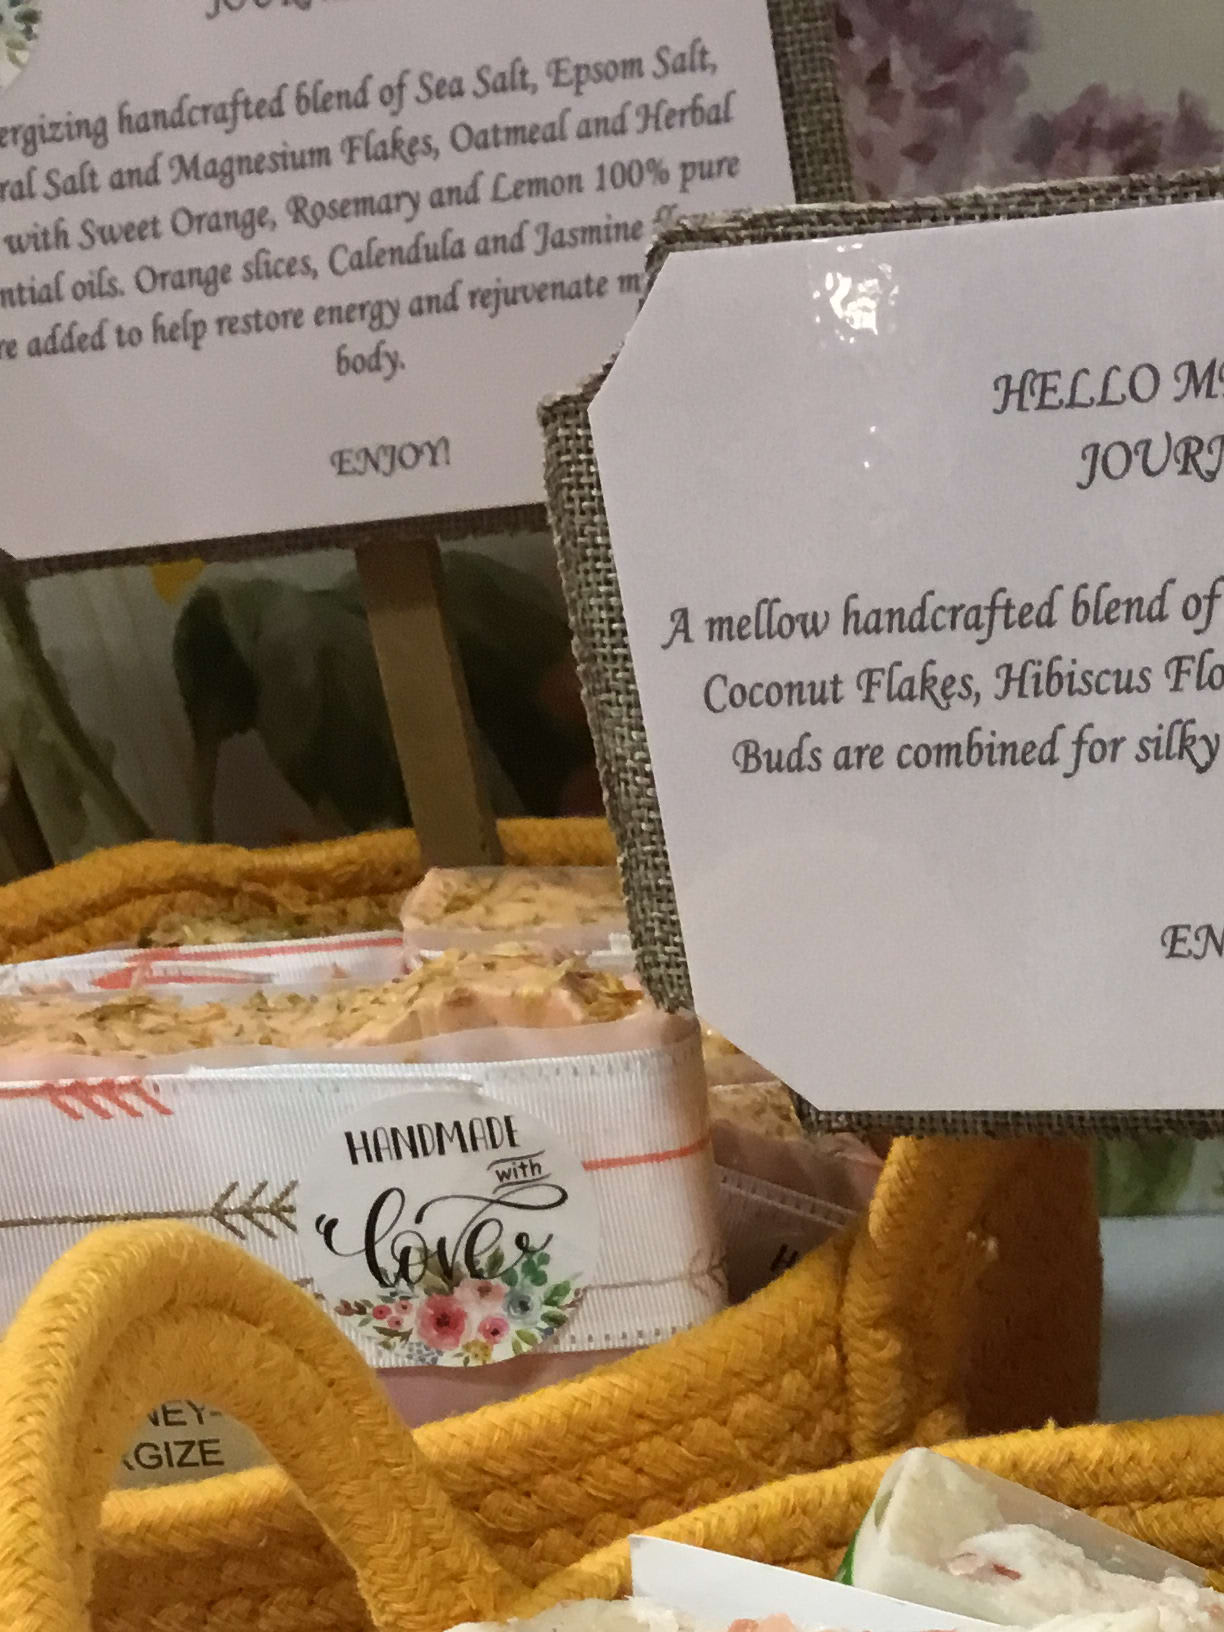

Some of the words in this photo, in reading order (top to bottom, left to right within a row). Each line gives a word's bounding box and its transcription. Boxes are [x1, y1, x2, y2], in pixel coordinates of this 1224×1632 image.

[118, 83, 288, 135] handcrafted
[295, 74, 374, 116] blend
[379, 69, 411, 116] of
[415, 71, 465, 104] Sea
[472, 56, 539, 99] Salt,
[546, 55, 645, 97] Epsom
[652, 36, 718, 79] Salt,
[43, 160, 101, 200] Salt
[108, 152, 163, 190] and
[168, 142, 332, 189] Magnesium
[340, 125, 440, 166] Flakes,
[449, 107, 572, 154] Oatmeal
[575, 100, 632, 140] and
[635, 89, 736, 135] Herbal
[3, 217, 70, 255] with
[77, 214, 162, 251] Sweet
[170, 205, 278, 241] Orange,
[286, 190, 420, 229] Rosemary
[429, 170, 485, 210] and
[489, 172, 585, 204] Lemon
[595, 156, 670, 193] 100%
[679, 154, 742, 194] pure
[71, 265, 126, 301] oils.
[134, 261, 232, 297] Orange
[242, 248, 319, 283] slices,
[328, 227, 466, 277] Calendula
[474, 219, 531, 257] and
[534, 213, 644, 257] Jasmine
[26, 318, 109, 358] added
[115, 315, 143, 348] to
[151, 308, 207, 351] help
[215, 307, 304, 337] restore
[313, 299, 401, 333] energy
[408, 279, 464, 318] and
[467, 273, 609, 319] rejuvenate
[335, 339, 406, 381] body.
[993, 362, 1160, 416] HELLO
[330, 436, 451, 477] ENJOY!
[660, 606, 695, 650] A
[705, 597, 829, 644] mellow
[841, 584, 1064, 645] handcrafted
[1071, 577, 1177, 628] blend
[702, 669, 845, 714] Coconut
[856, 657, 983, 711] Flakes,
[994, 651, 1153, 701] Hibiscus
[732, 728, 823, 775] Buds
[832, 737, 885, 774] are
[896, 720, 1069, 770] combined
[1063, 720, 1128, 780] for
[1134, 716, 1221, 774] silky
[344, 1114, 521, 1166] HANDMADE
[495, 1158, 543, 1184] with
